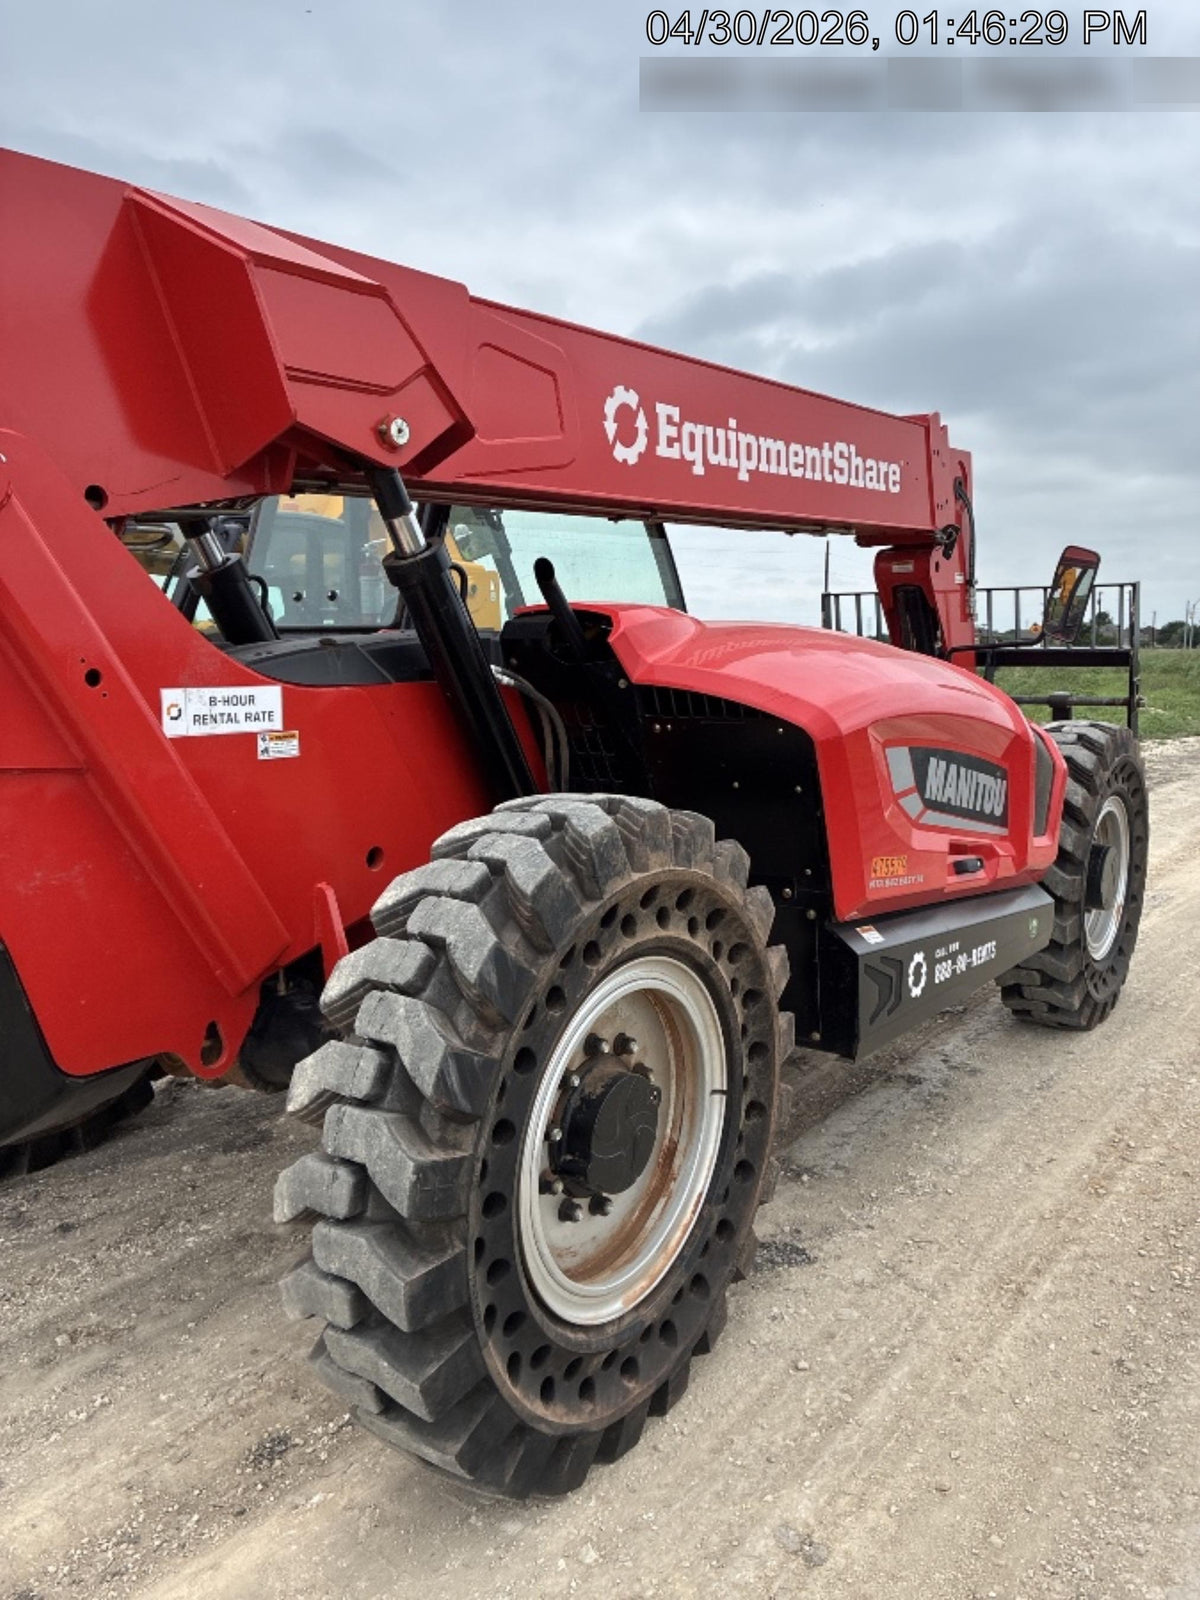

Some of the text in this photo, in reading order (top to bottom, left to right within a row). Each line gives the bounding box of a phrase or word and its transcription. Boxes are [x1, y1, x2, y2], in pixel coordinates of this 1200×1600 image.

[655, 401, 901, 494] EquipmentShare
[193, 710, 275, 726] RENTAL RATE
[925, 757, 1007, 816] MANITOU
